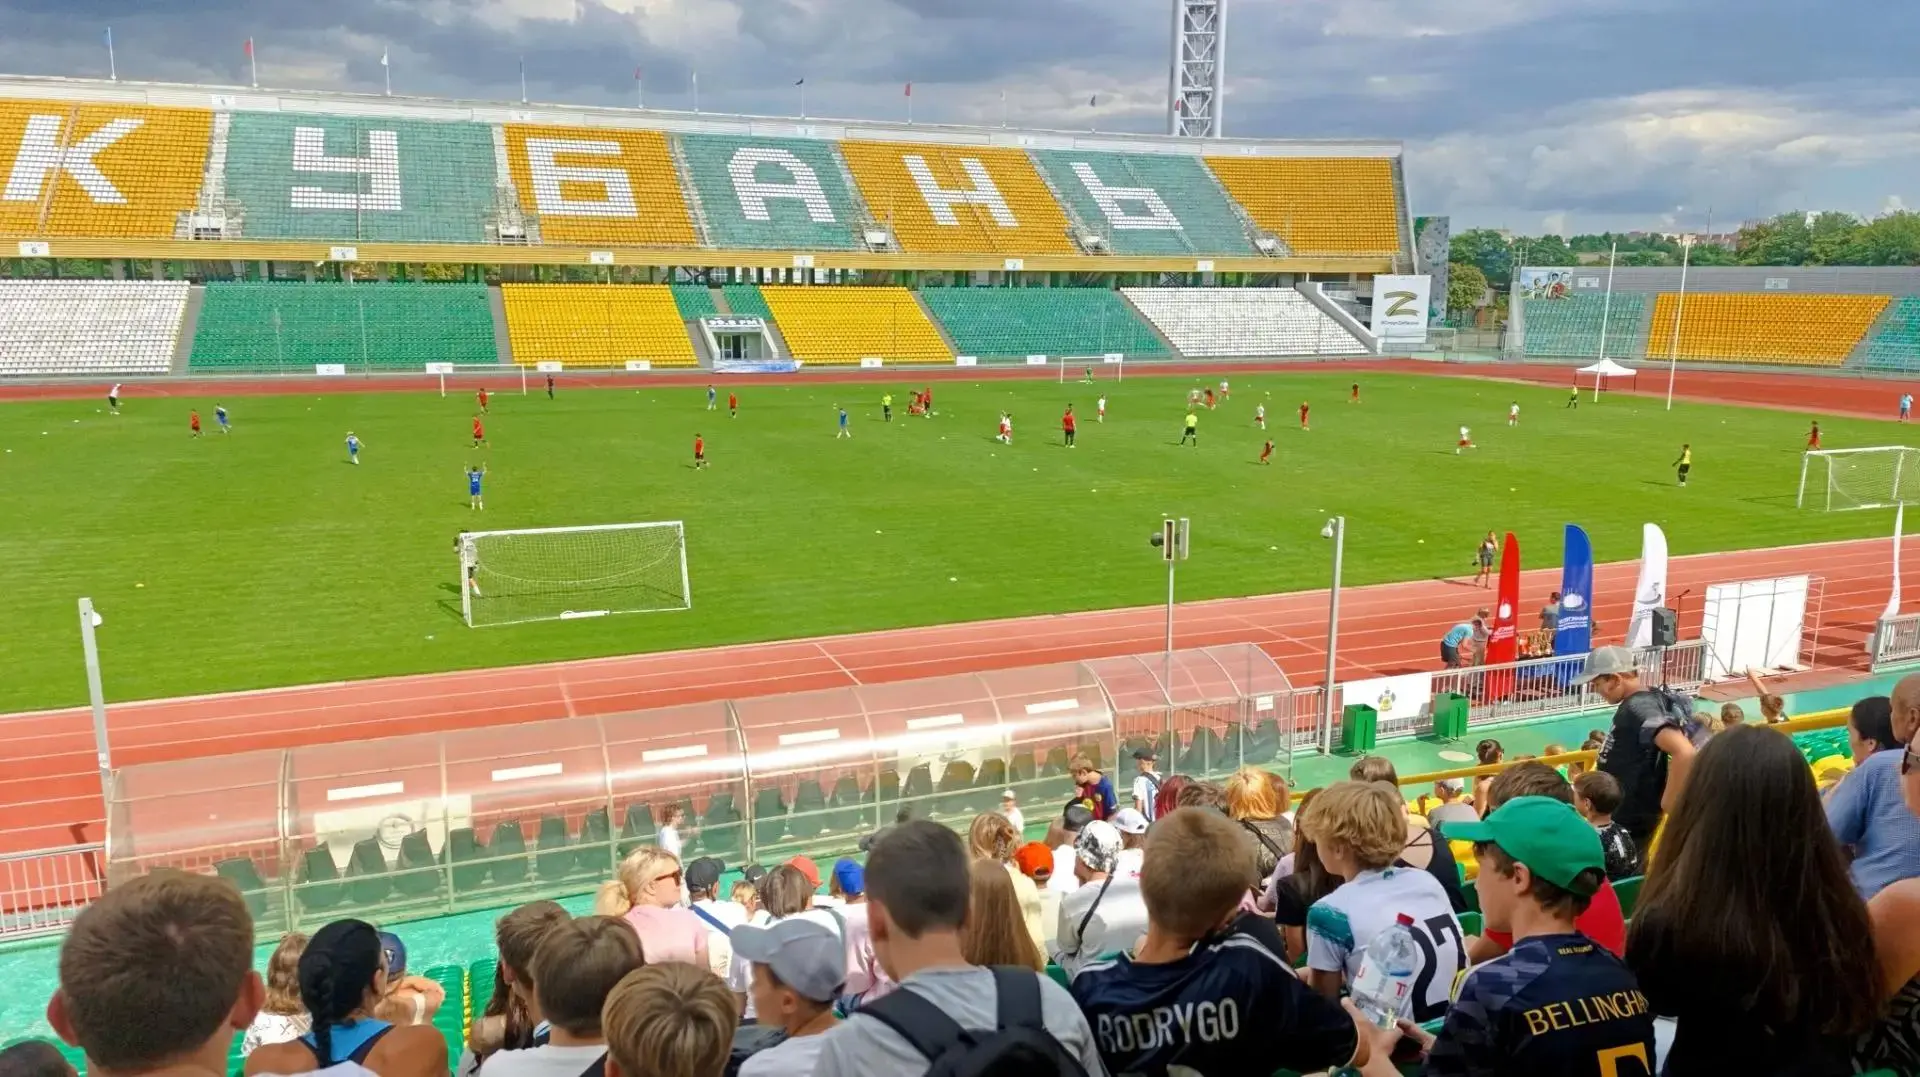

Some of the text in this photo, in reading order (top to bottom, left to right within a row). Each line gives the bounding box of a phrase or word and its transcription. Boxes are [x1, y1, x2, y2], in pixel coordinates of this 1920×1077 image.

[3, 114, 1184, 230] КУБАНЬ
[1383, 291, 1420, 317] Z
[1098, 997, 1239, 1053] RODRYGO
[1523, 989, 1650, 1036] BELLINGHA
